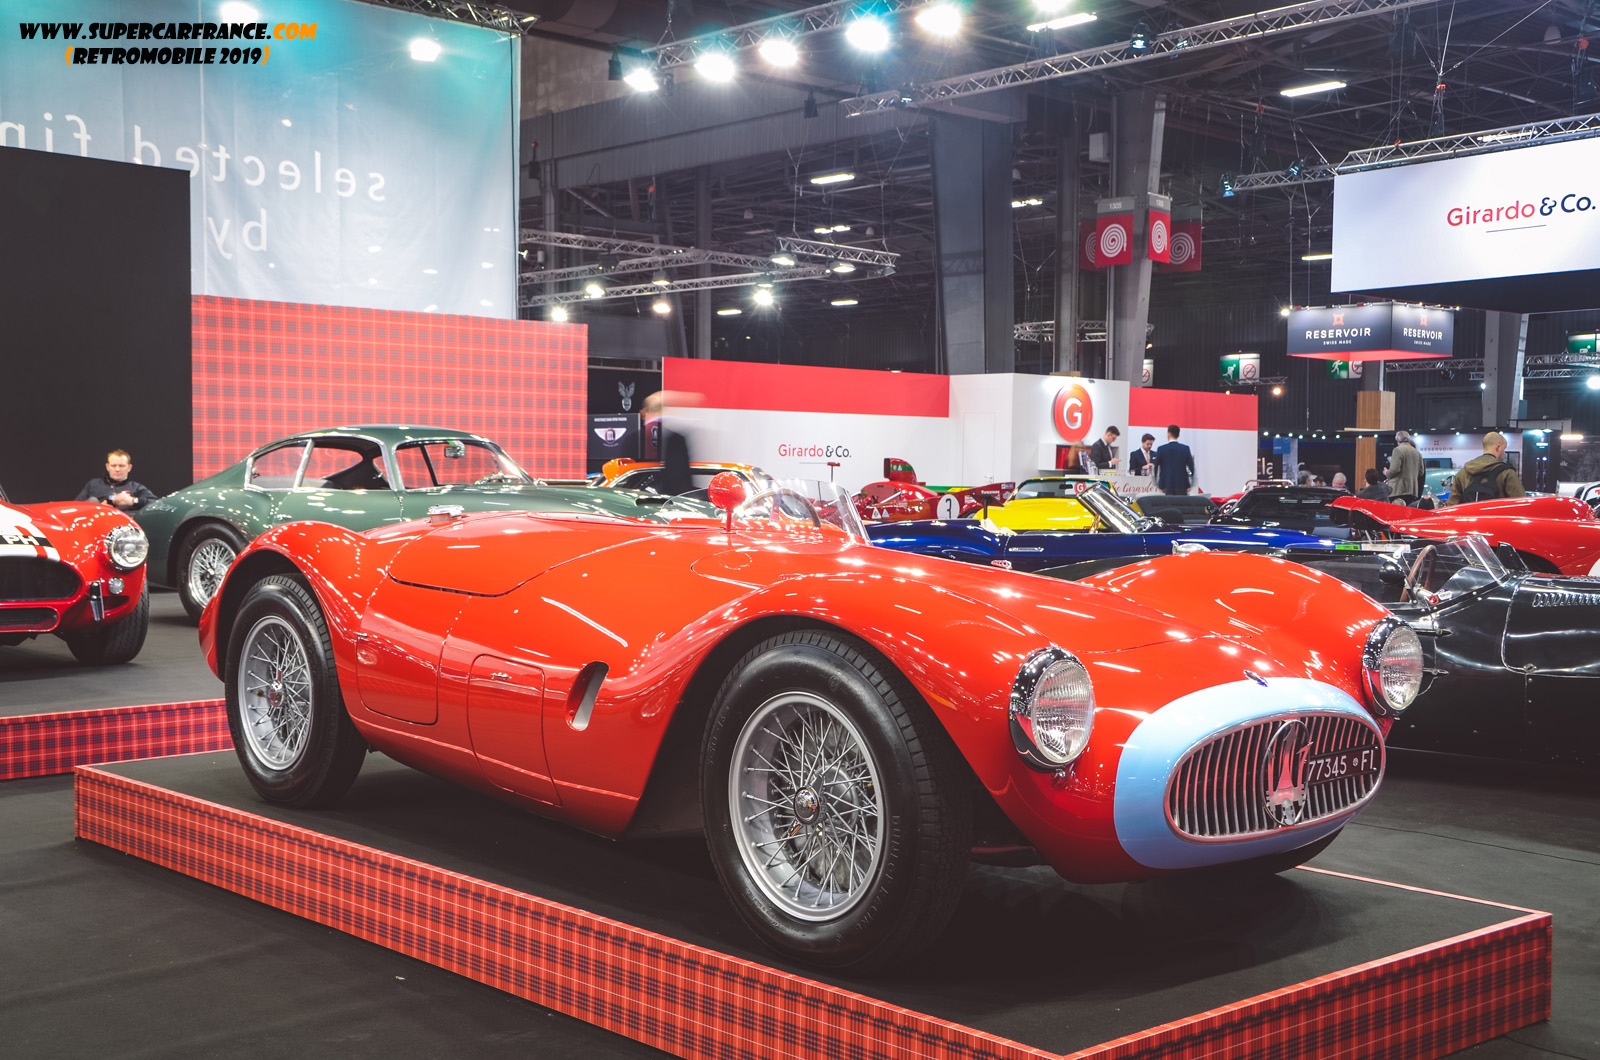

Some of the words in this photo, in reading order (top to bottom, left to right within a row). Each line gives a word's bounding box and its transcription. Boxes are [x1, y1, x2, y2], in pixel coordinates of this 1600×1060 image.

[1446, 200, 1536, 227] Girardo
[1539, 196, 1557, 217] &
[1560, 193, 1597, 213] Co.
[1305, 327, 1371, 340] RESERVOIR
[1403, 327, 1443, 341] RESERVOIR
[1063, 397, 1082, 430] G
[778, 443, 824, 457] Girardo
[825, 445, 834, 458] &
[835, 445, 852, 458] Co.
[1308, 755, 1348, 781] 77345
